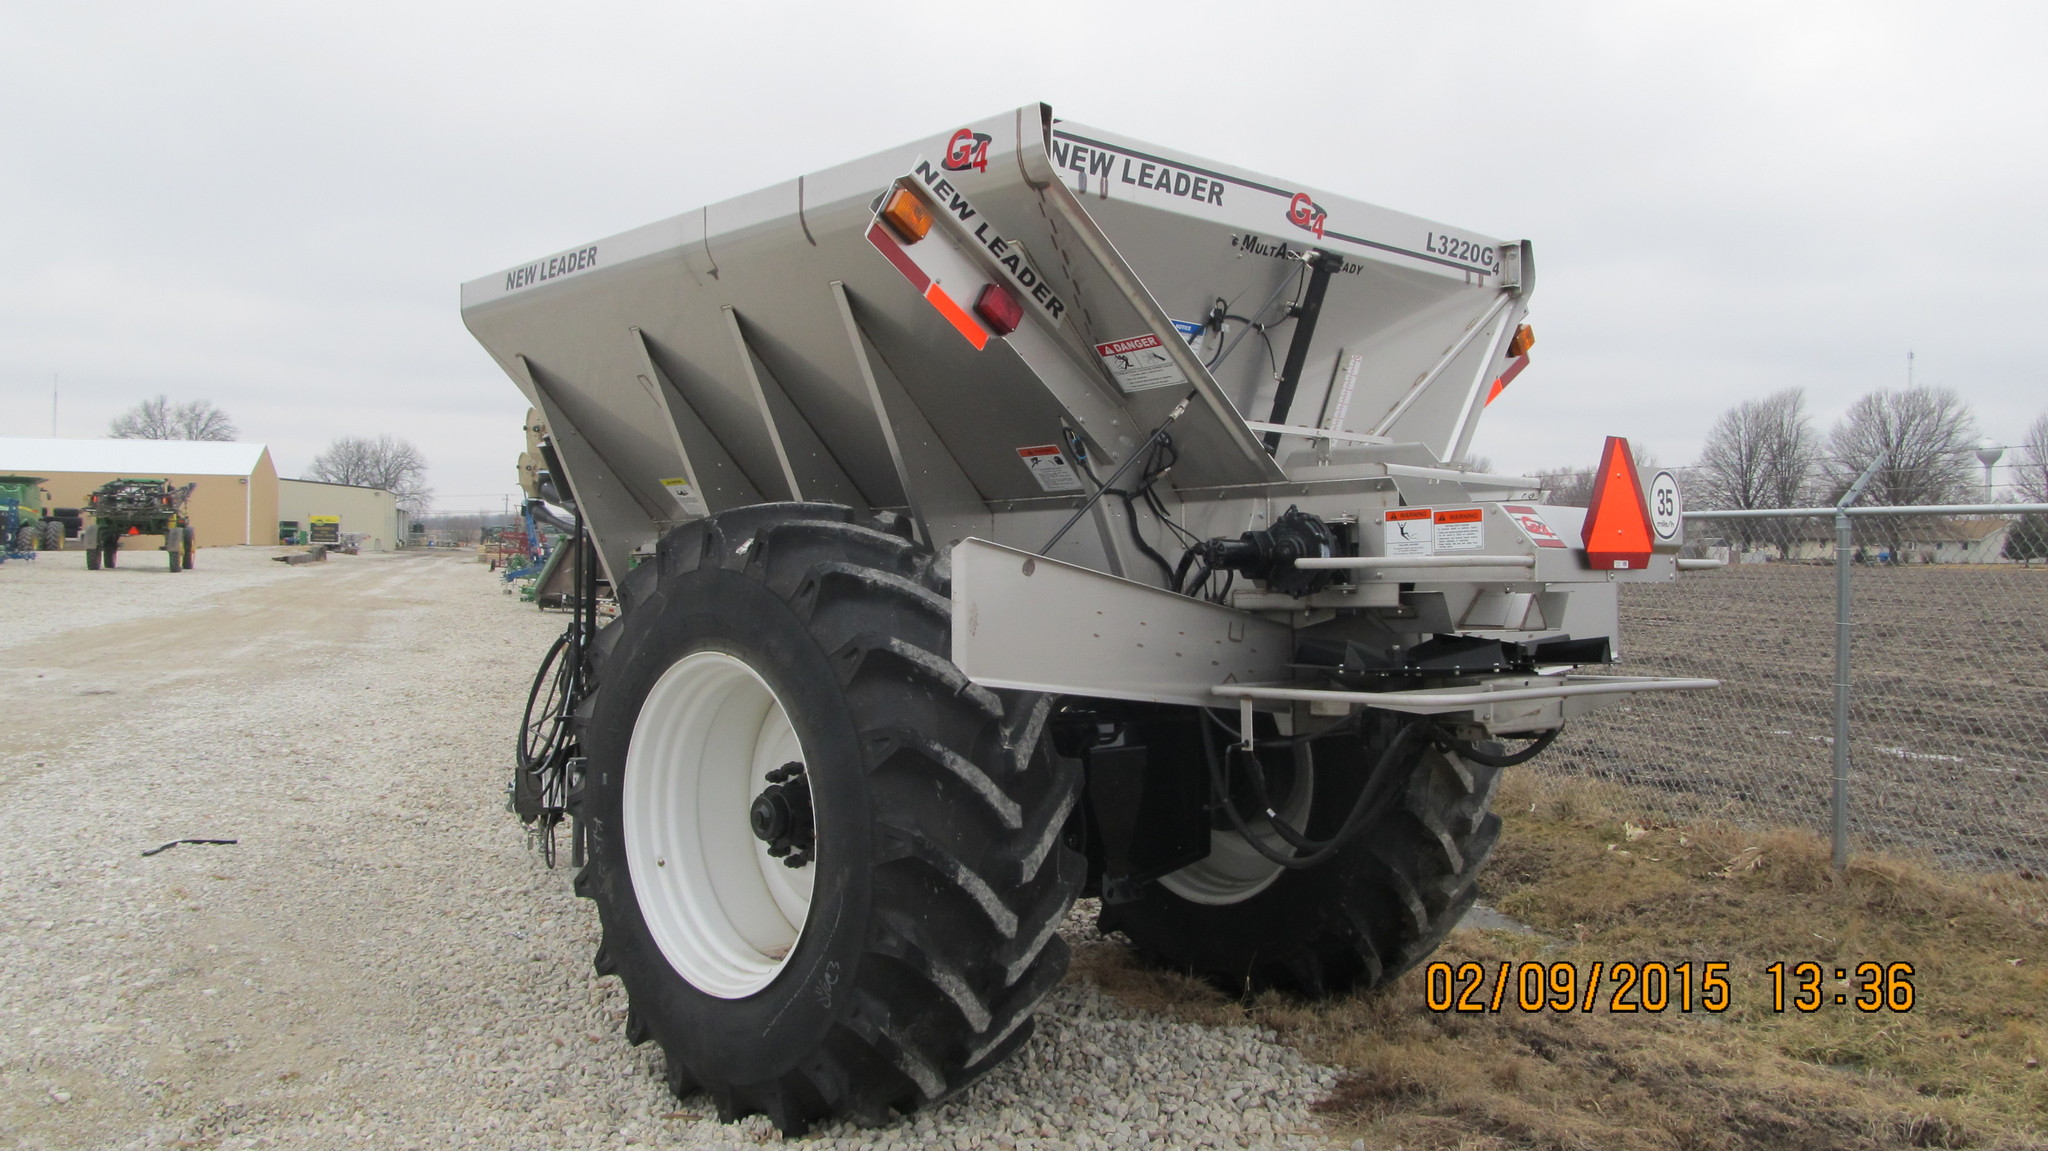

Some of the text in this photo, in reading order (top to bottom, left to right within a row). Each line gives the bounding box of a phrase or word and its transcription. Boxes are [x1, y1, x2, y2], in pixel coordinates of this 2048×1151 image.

[945, 128, 989, 173] G4
[1053, 140, 1225, 207] NEW LEADER
[1289, 192, 1325, 240] G4
[915, 160, 1065, 319] NEW LEADER
[1426, 231, 1500, 276] L3220G4
[505, 245, 598, 291] NEW LEADER
[1113, 336, 1158, 353] DANGER
[1657, 488, 1674, 517] 35
